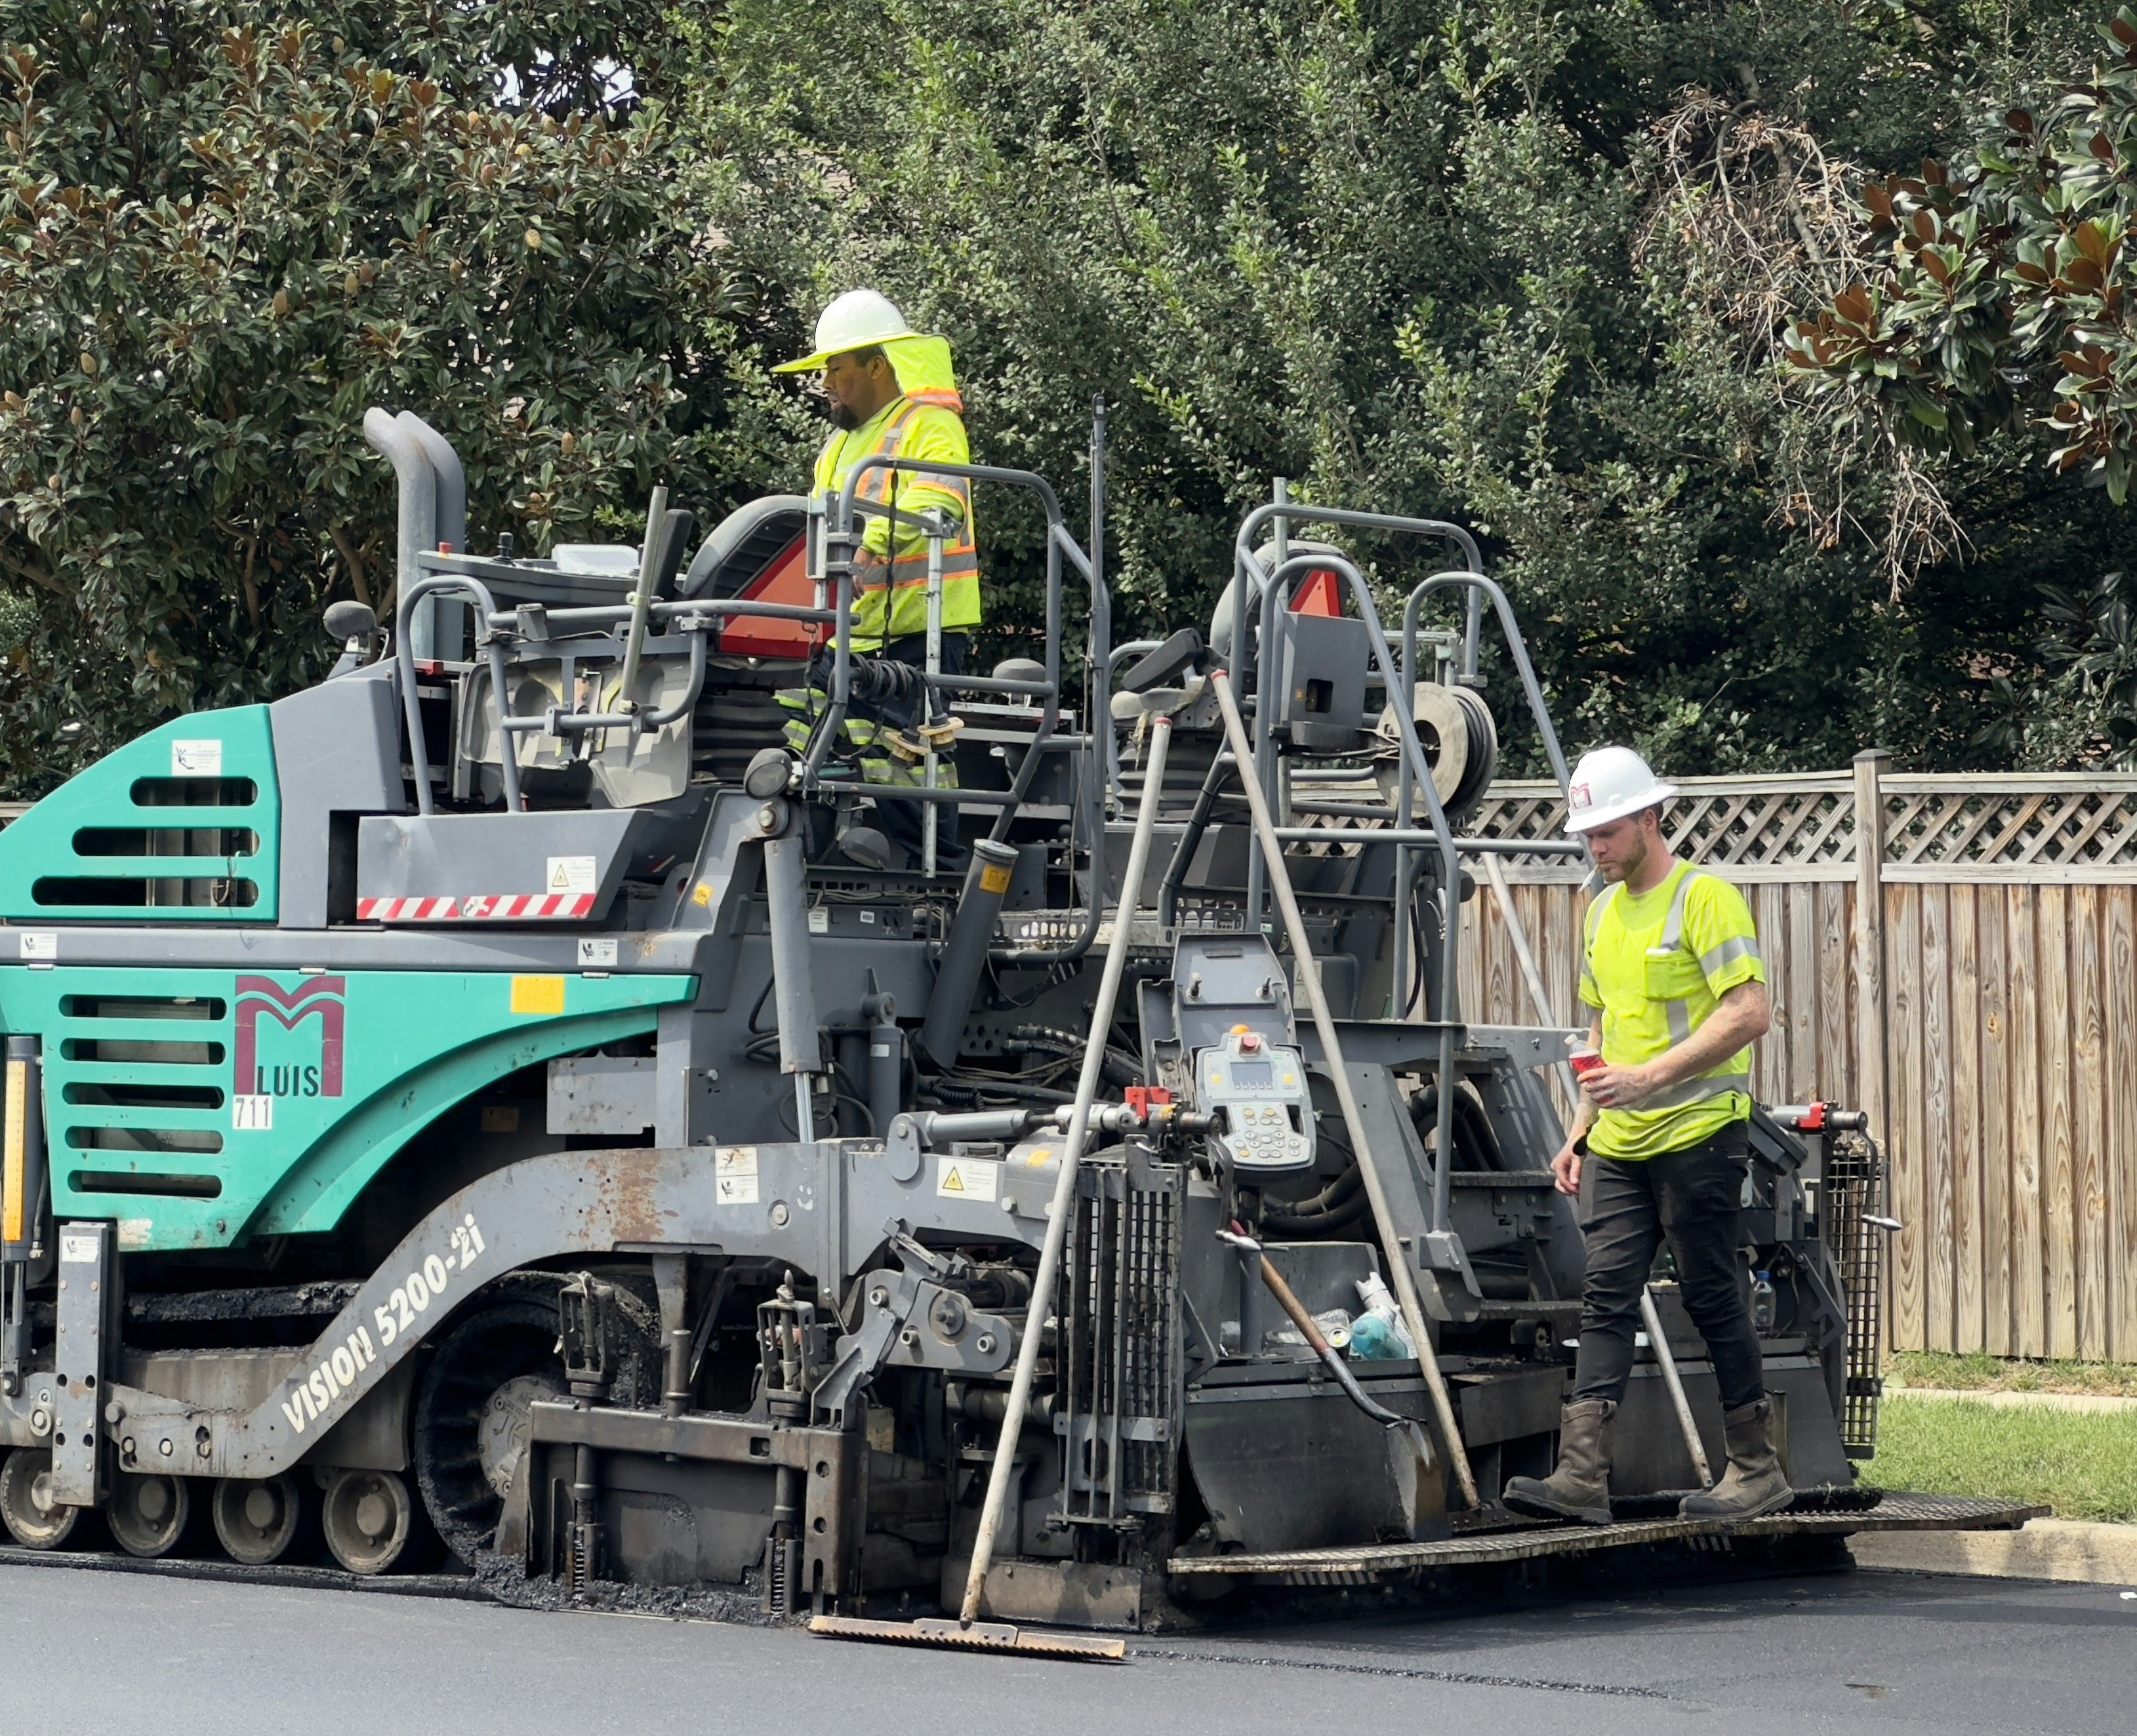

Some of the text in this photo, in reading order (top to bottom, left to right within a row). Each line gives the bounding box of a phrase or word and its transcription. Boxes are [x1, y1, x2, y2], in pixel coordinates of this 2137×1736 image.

[256, 1065, 319, 1097] LUIS
[235, 1097, 269, 1128] 711
[281, 1213, 485, 1434] VISION 5200-2i
